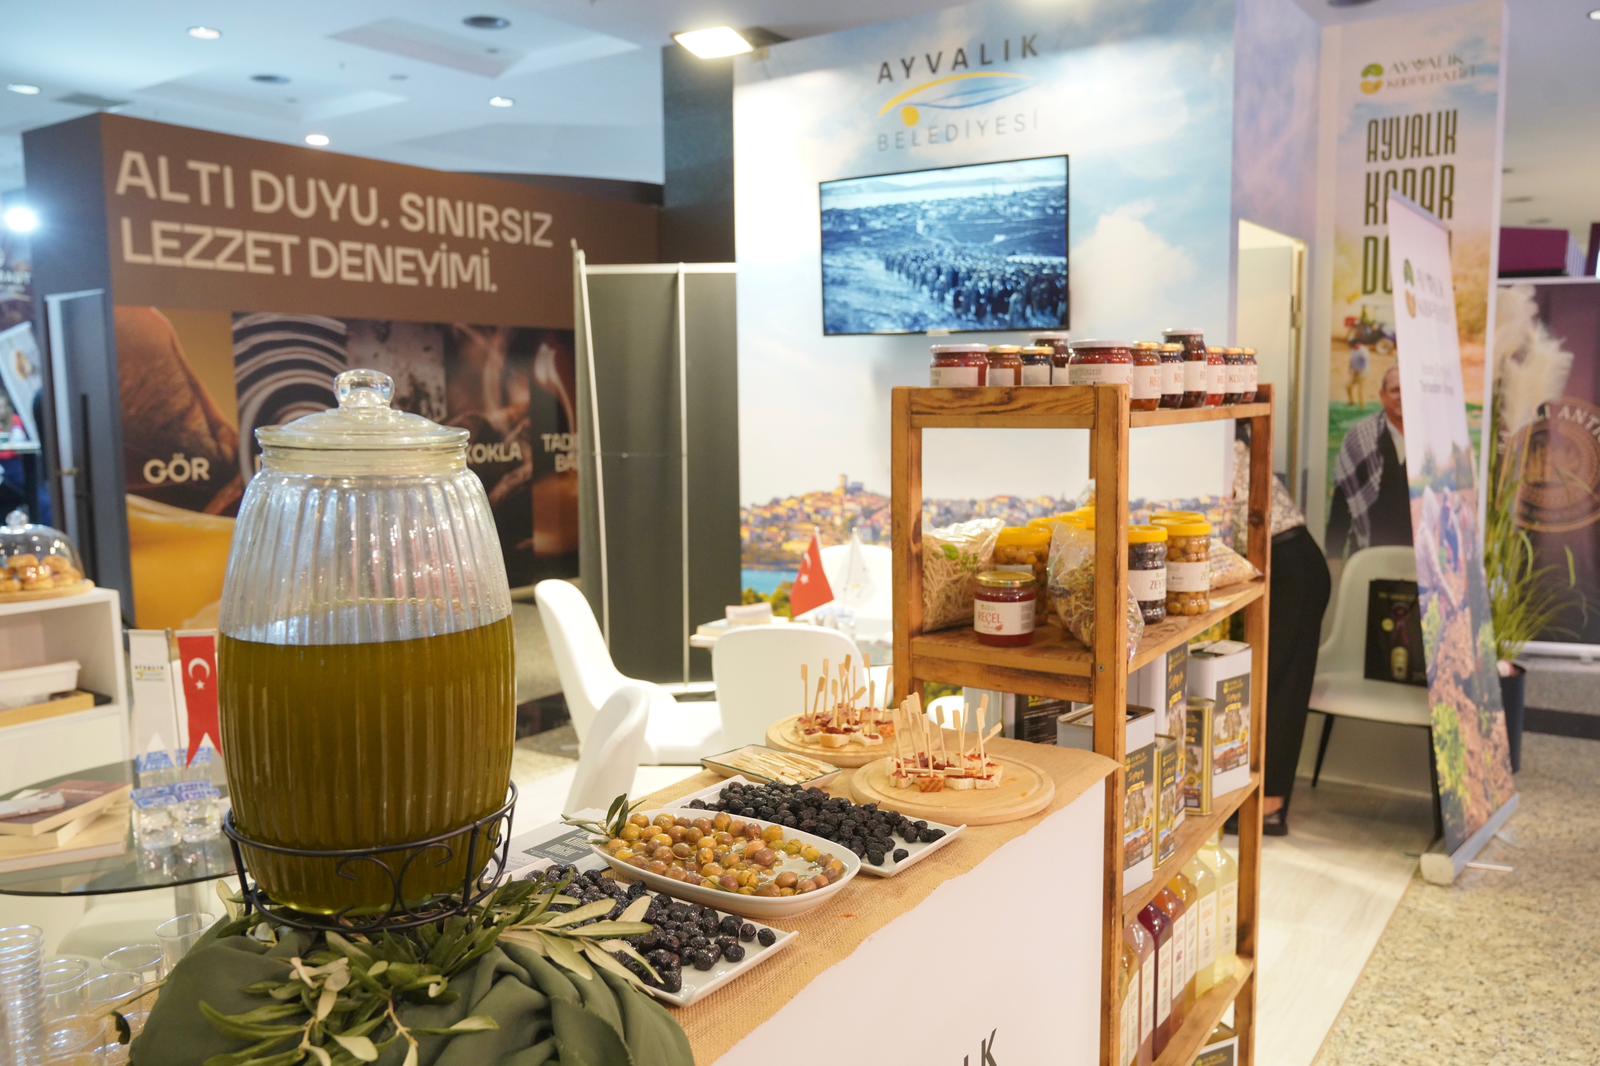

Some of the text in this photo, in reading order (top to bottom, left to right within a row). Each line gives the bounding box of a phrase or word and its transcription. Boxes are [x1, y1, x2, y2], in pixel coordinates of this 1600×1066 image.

[877, 34, 1039, 84] AYVALIK
[876, 107, 1039, 152] BELEDİYESİ
[1366, 109, 1458, 163] AYVALIK
[115, 149, 555, 249] ALTI DUYU. SINIRSIZ
[120, 216, 498, 293] LEZZET DENEYİMİ.
[143, 452, 211, 484] GÖR
